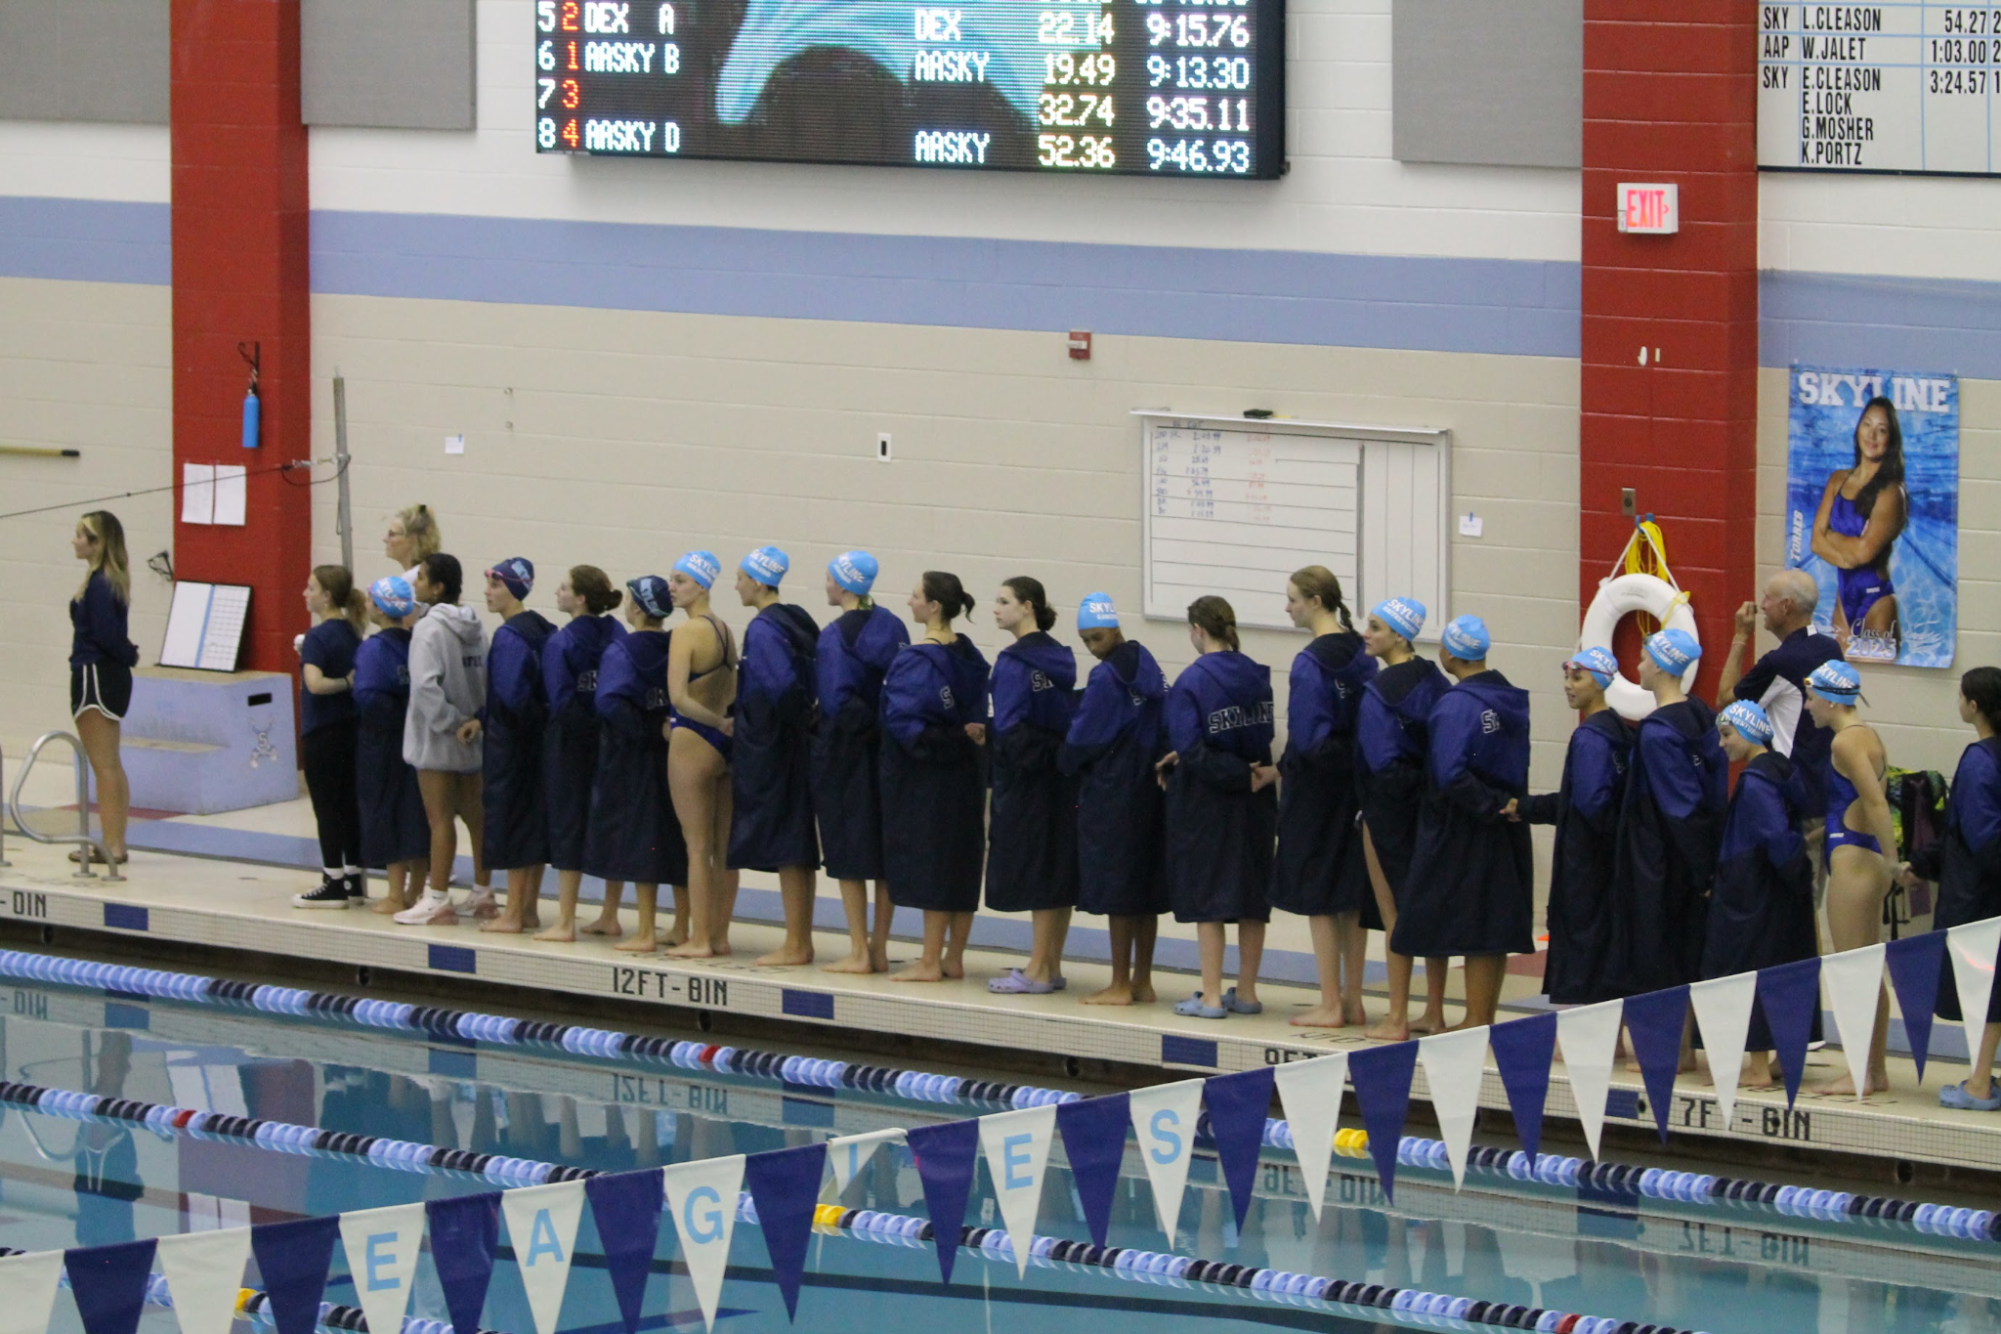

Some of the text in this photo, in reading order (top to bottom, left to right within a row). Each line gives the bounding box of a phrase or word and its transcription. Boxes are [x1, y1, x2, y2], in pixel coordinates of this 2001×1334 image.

[538, 2, 1250, 47] 5 2 DEX A DEX 22.14 9:15.76
[1764, 6, 1789, 30] SKY
[1803, 7, 1881, 32] L.CLEASON
[1945, 10, 1987, 34] 54.27
[538, 41, 1250, 89] 6 1 AASKY B AASKY 19.49 9:13.30
[1764, 35, 1789, 59] AAP
[1803, 36, 1866, 61] W.JALET
[1932, 39, 1986, 64] 1:03.00
[1763, 66, 1789, 89] SKY
[1803, 67, 1881, 91] E.CLEASON
[1930, 70, 1986, 94] 3:24.57
[538, 79, 1250, 131] 7 3 32.74 9:35.11
[1802, 91, 1852, 115] E.LOCK
[538, 118, 1250, 173] 8 4 AASKY D AASKY 52.36 9:46.93
[1802, 116, 1874, 141] G.MOSHER
[1802, 141, 1862, 165] K.PORTZ
[1626, 190, 1665, 228] EXIT
[1089, 602, 1115, 613] SKYL
[1387, 599, 1424, 629] SKYLIN
[1851, 617, 1897, 638] Class of
[1729, 704, 1771, 735] SKYLINE
[1150, 1109, 1182, 1165] S
[1680, 1097, 1810, 1140] 7F-6IN
[1004, 1133, 1034, 1190] E
[684, 1186, 724, 1244] G
[526, 1209, 564, 1267] A
[365, 1232, 400, 1291] E
